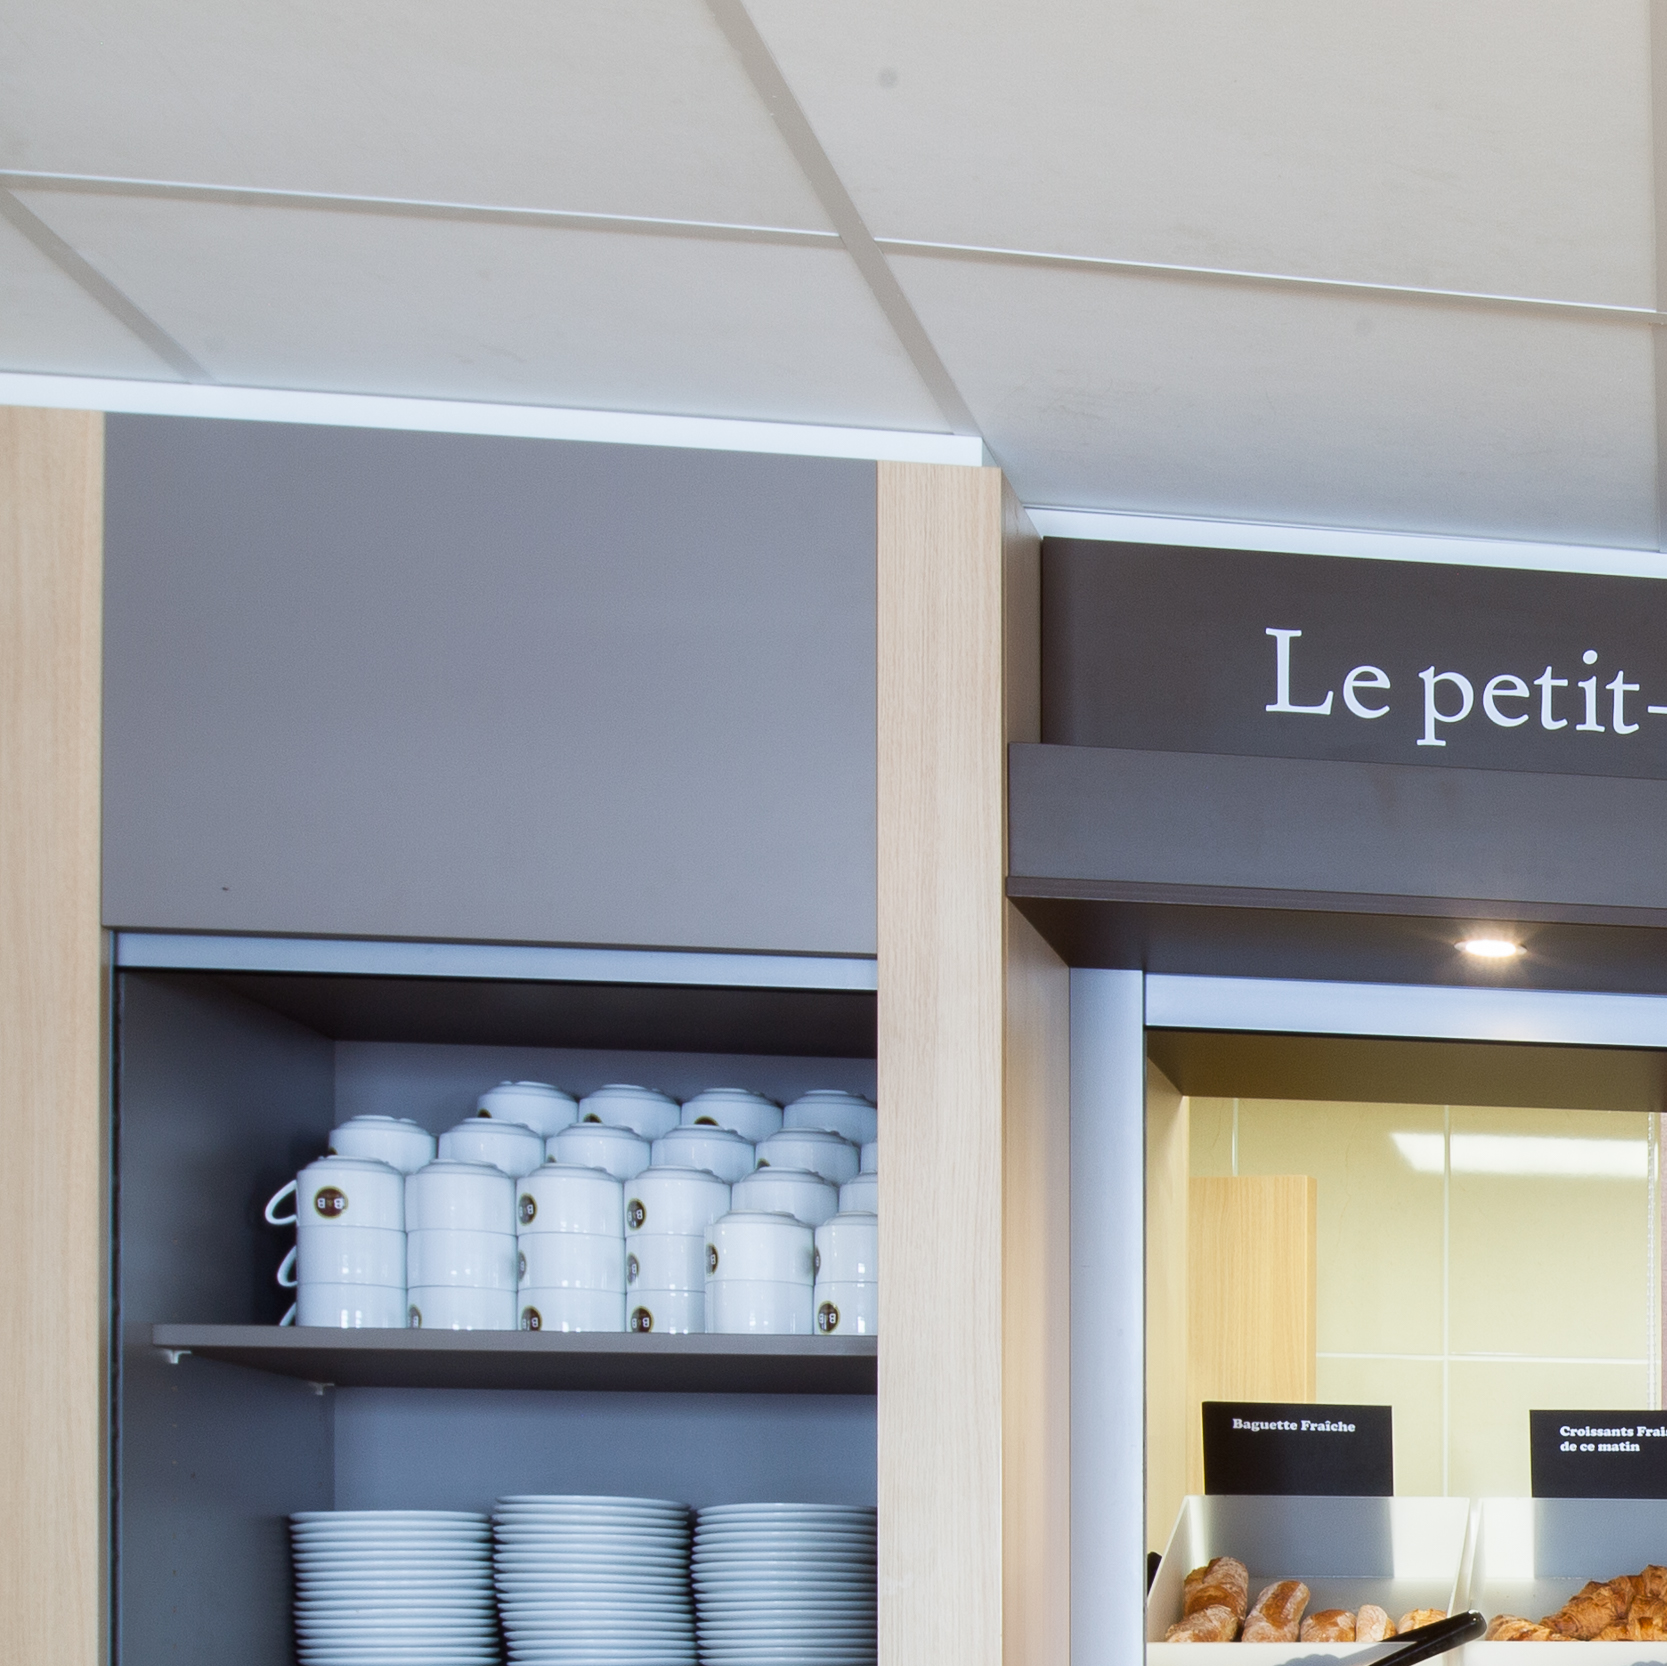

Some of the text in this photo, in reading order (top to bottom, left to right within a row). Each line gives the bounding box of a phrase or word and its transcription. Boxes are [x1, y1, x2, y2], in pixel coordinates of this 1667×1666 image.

[1265, 626, 1390, 720] Le
[1232, 1418, 1356, 1433] Baguette Fraîche
[1559, 1426, 1635, 1438] Croissants
[1559, 1441, 1641, 1452] de ce matin
